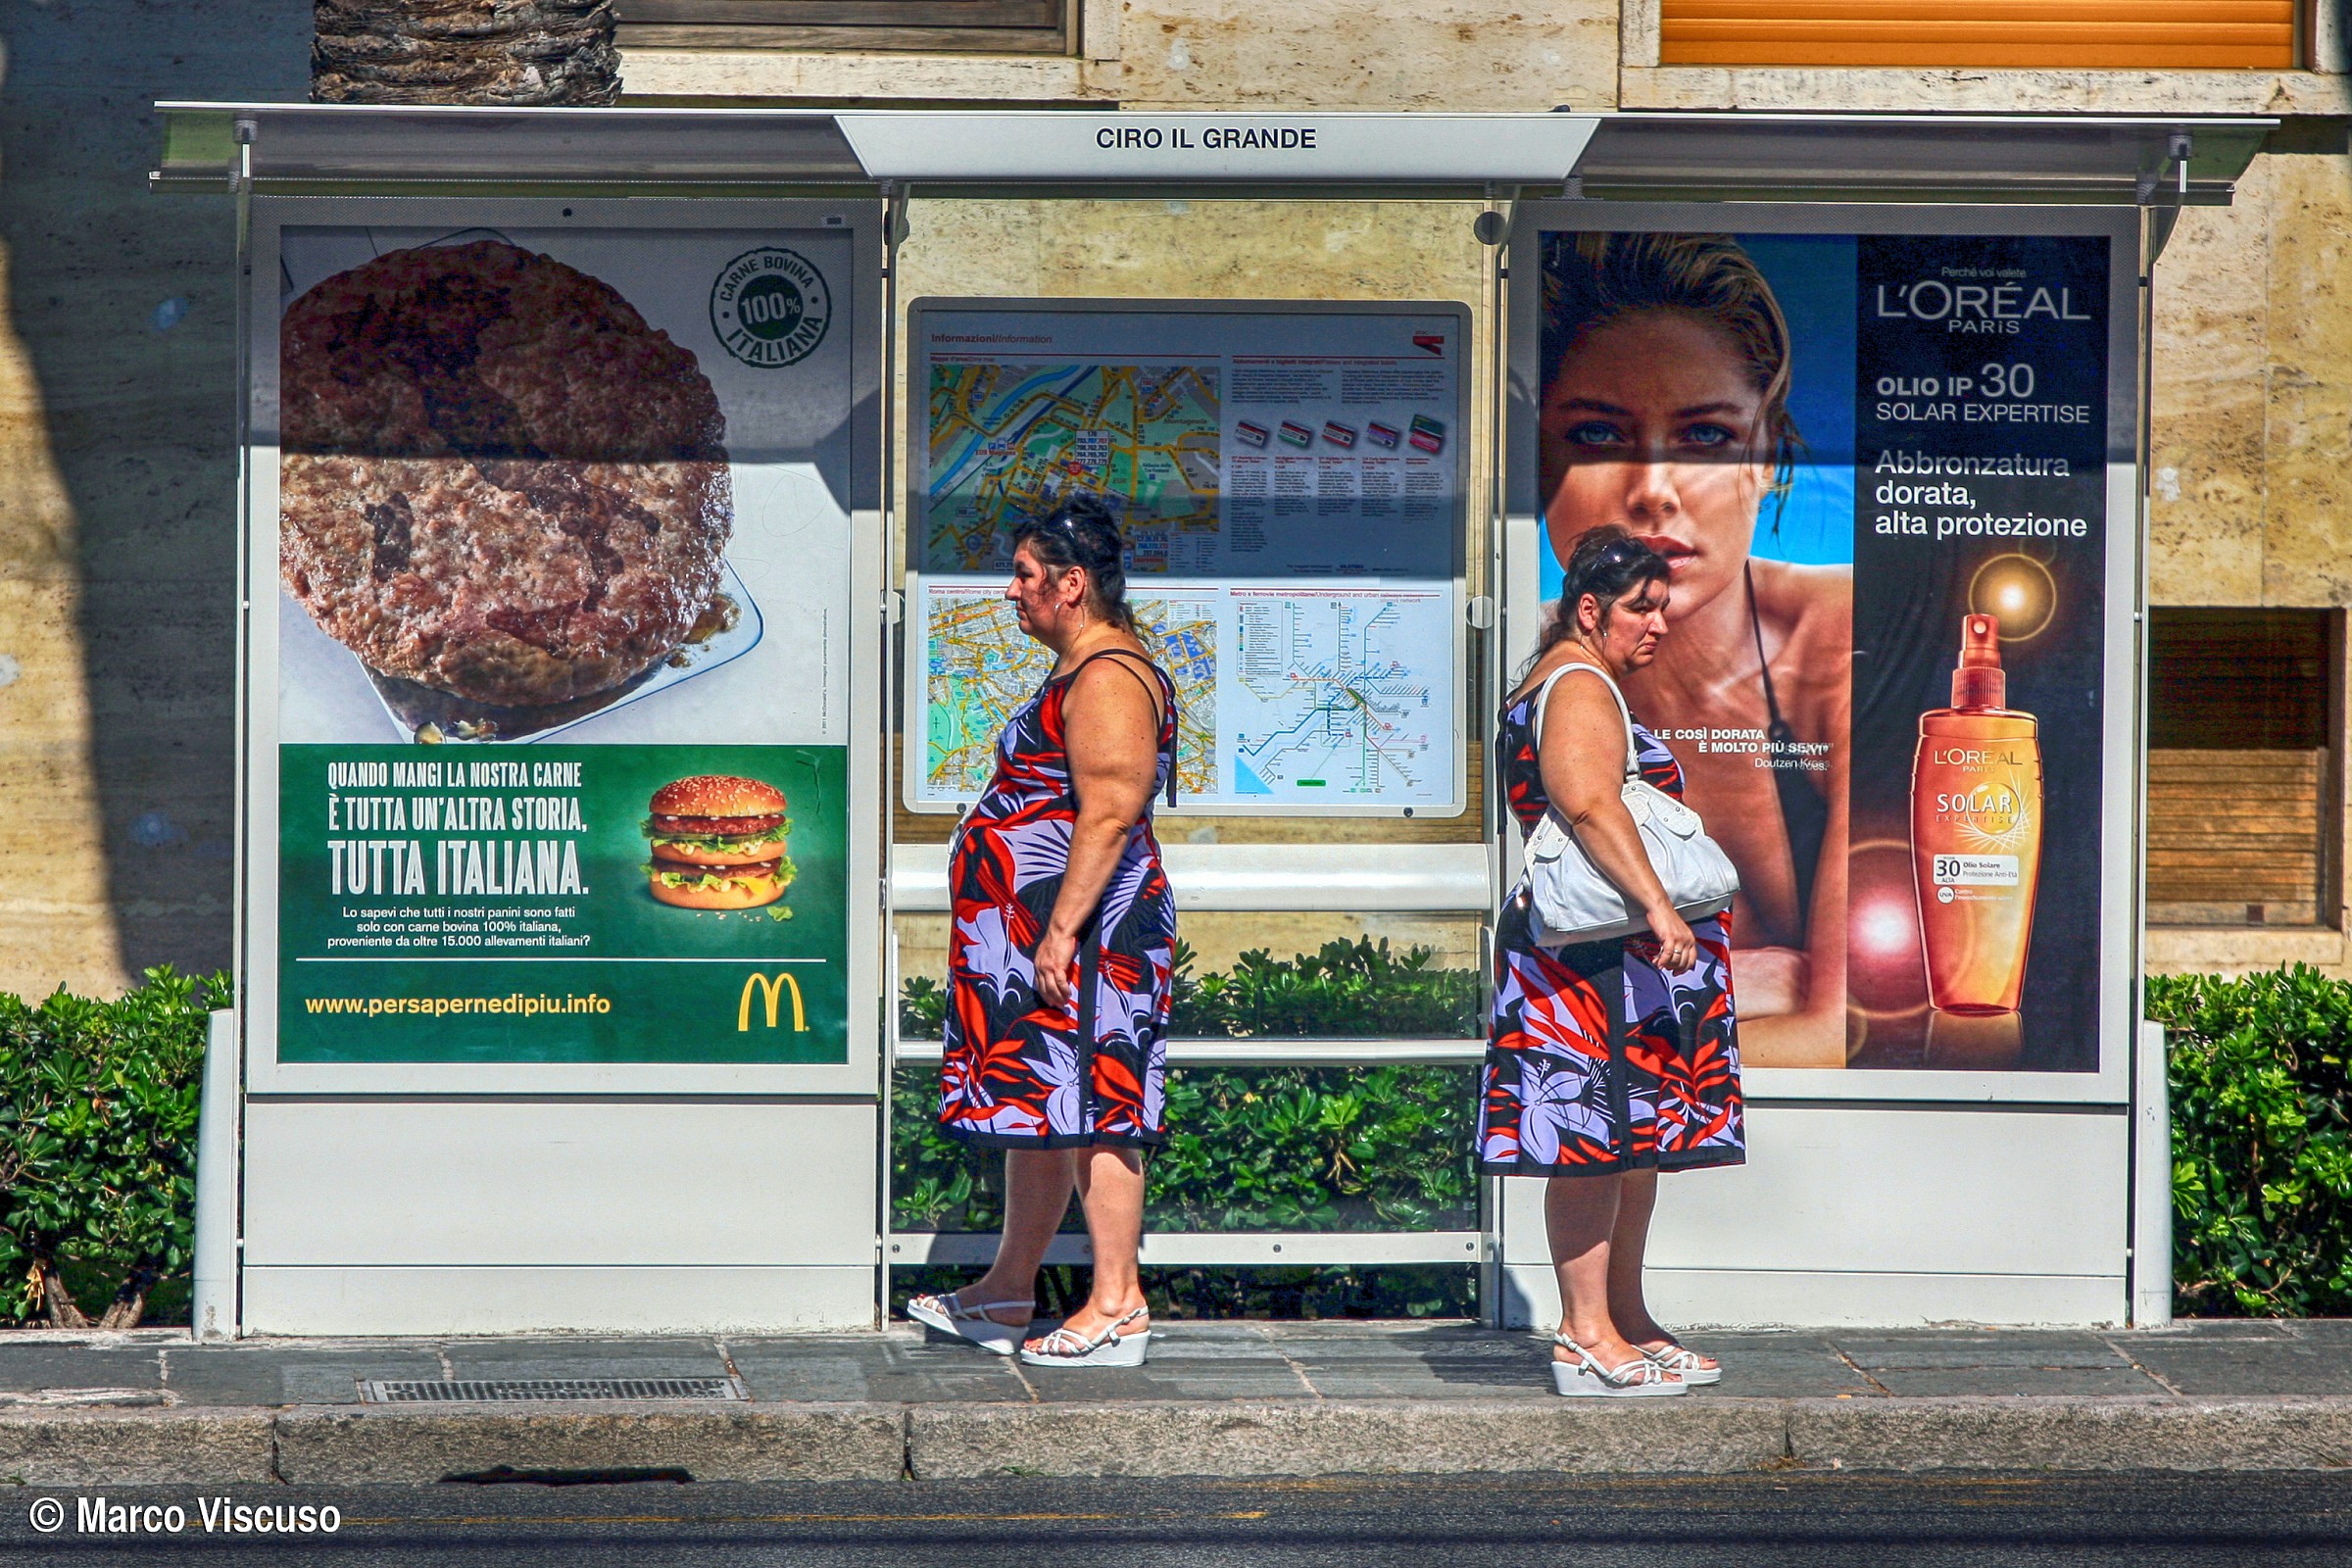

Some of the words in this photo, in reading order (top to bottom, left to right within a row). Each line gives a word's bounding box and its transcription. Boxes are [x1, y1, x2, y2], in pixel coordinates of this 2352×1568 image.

[1096, 127, 1163, 148] CIRO
[1172, 127, 1195, 148] IL
[1202, 127, 1317, 148] GRANDE
[719, 259, 760, 302] CARNE
[763, 256, 814, 288] BOVINA
[740, 292, 801, 324] 100%
[726, 317, 823, 362] ITALIANA
[1877, 376, 1940, 396] OLIO
[1948, 377, 1974, 396] IP
[1981, 363, 2034, 398] 30
[1876, 402, 1957, 421] SOLAR
[1964, 404, 2090, 423] EXPERTISE
[1875, 450, 2071, 477] Abbronzatura
[1875, 479, 1977, 510] dorata,
[1875, 510, 1929, 535] alta
[1936, 513, 2087, 540] protezione
[1675, 726, 1707, 740] COSÌ
[1711, 729, 1766, 740] DORATA
[1698, 740, 1708, 753] È
[1711, 742, 1758, 753] MOLTO
[1761, 739, 1785, 753] PIÙ
[1754, 758, 1798, 769] Doutzen
[327, 761, 388, 789] QUANDO
[393, 761, 442, 788] MANGI
[447, 761, 466, 788] LA
[470, 761, 529, 788] NOSTRA
[533, 761, 582, 788] CARNE
[327, 793, 340, 831] È
[344, 797, 407, 831] TUTTA
[512, 797, 588, 833] STORIA,
[1936, 793, 2013, 813] SOLAR
[1936, 814, 2013, 824] EXPERTISE
[327, 840, 425, 896] TUTTA
[437, 840, 589, 896] ITALIANA.
[1936, 859, 1961, 877] 30
[342, 906, 358, 918] Lo
[361, 906, 396, 920] sapevi
[399, 906, 420, 918] che
[423, 906, 445, 918] tutti
[454, 906, 485, 918] nostri
[488, 906, 520, 920] panini
[523, 907, 552, 918] sono
[555, 906, 575, 918] fatti
[357, 920, 381, 933] solo
[383, 922, 405, 933] con
[408, 922, 440, 933] carne
[442, 920, 479, 933] bovina
[482, 921, 516, 933] 100%
[519, 920, 562, 934] italiana,
[327, 935, 392, 949] proveniente
[396, 935, 410, 948] da
[413, 935, 438, 948] oltre
[442, 935, 481, 948] 15.000
[484, 935, 546, 948] allevamenti
[549, 935, 591, 948] italiani?
[305, 993, 612, 1017] www.persapernedipiu.info
